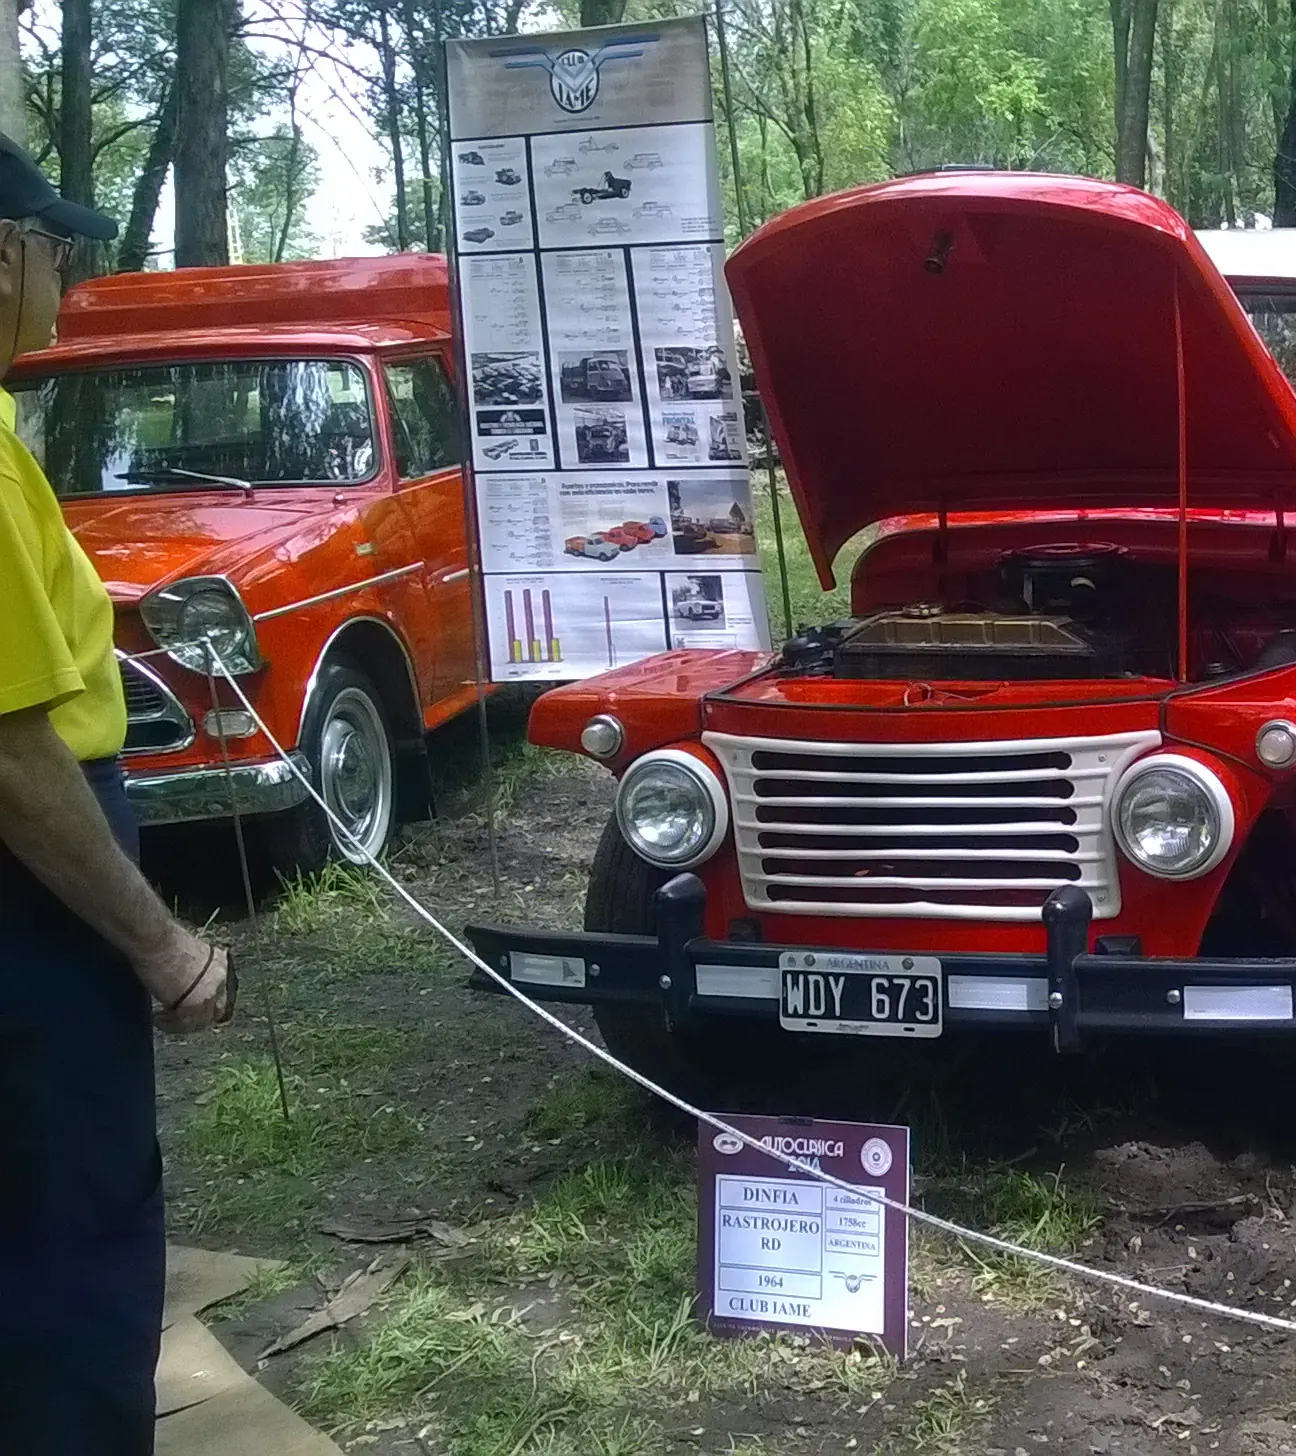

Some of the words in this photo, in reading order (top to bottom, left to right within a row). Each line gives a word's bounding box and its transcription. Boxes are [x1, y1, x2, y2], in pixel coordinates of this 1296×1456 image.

[558, 77, 594, 109] IAME
[826, 957, 890, 971] ARGENTINA
[786, 972, 846, 1017] WDY
[871, 977, 934, 1021] 673
[743, 1187, 800, 1205] DINFIA
[833, 1195, 838, 1203] 4
[722, 1214, 820, 1235] RASTROJERO
[761, 1237, 782, 1251] RD
[828, 1239, 876, 1251] ARGENTINA
[758, 1275, 784, 1289] 1964
[728, 1297, 769, 1314] CLUB
[772, 1301, 812, 1318] IAME
